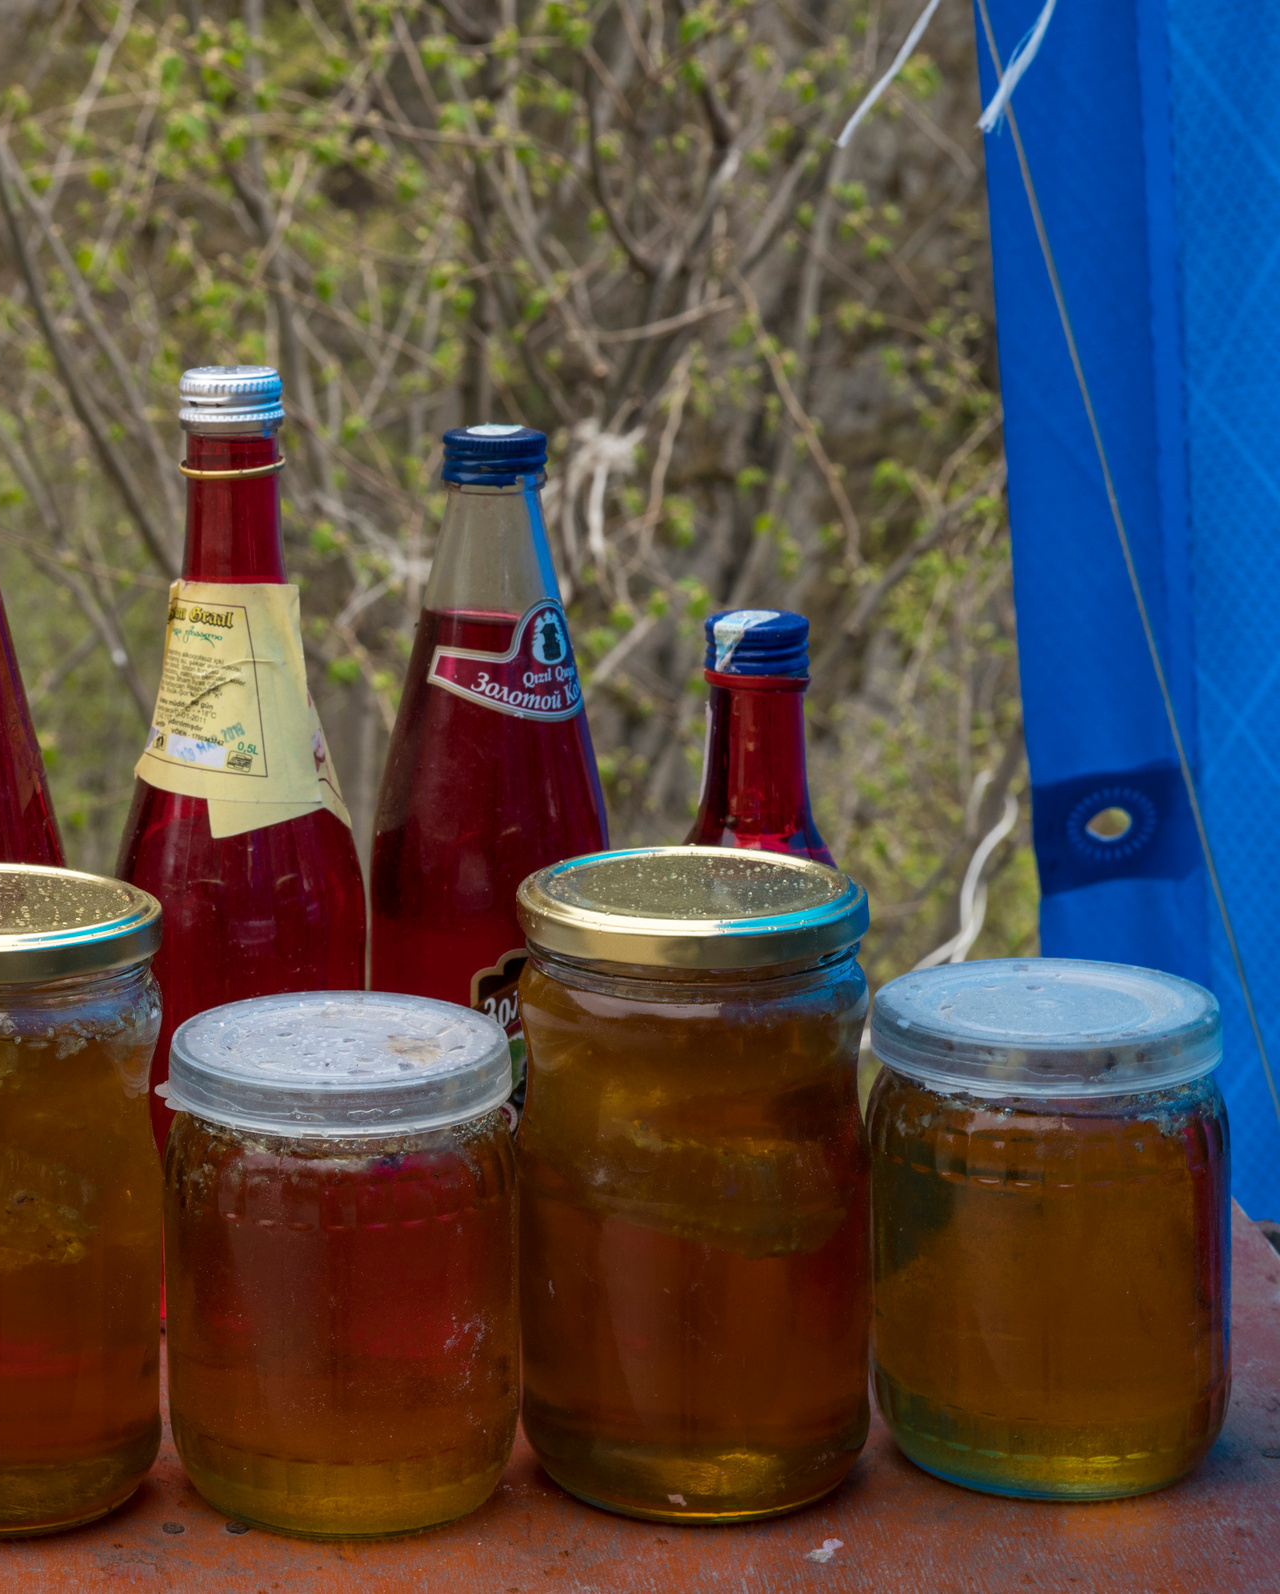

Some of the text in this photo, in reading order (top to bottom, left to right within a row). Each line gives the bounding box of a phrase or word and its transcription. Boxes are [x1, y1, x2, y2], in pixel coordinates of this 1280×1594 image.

[189, 605, 234, 629] Graal
[470, 672, 563, 710] Золотой
[237, 741, 259, 755] 0,5L
